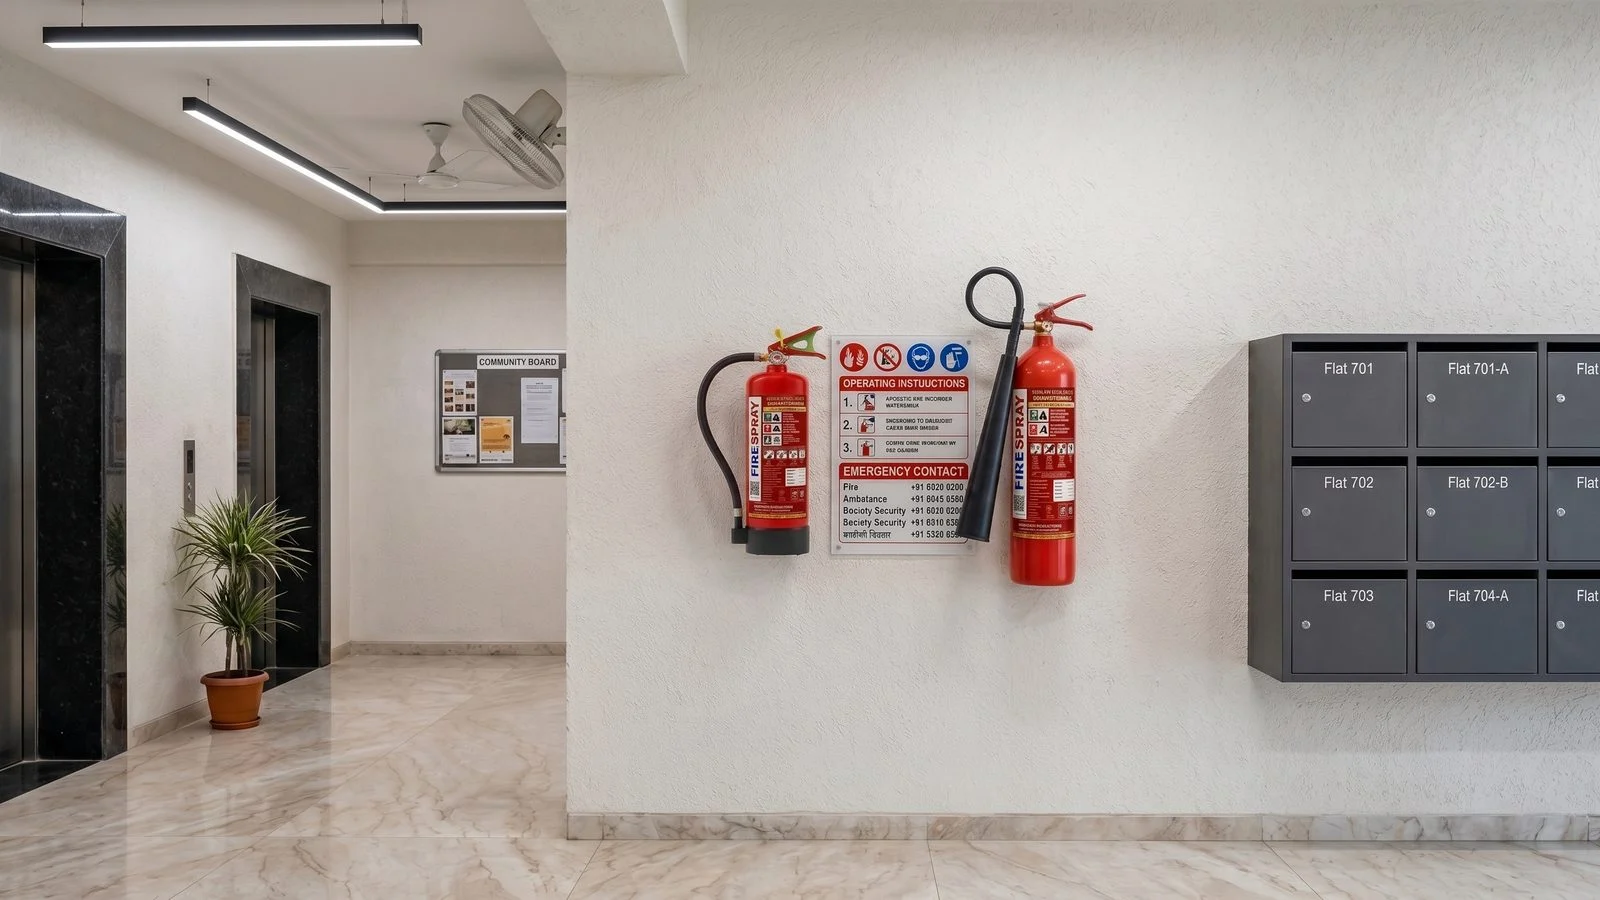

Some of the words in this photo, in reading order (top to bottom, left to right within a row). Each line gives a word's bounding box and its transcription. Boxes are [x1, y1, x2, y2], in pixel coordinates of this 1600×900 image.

[479, 358, 526, 366] COMMUNITY
[528, 358, 557, 366] BOARD
[1324, 362, 1348, 375] Flat
[1351, 362, 1374, 375] 701
[1448, 362, 1471, 375] Flat
[1474, 362, 1509, 375] 701-A
[1577, 362, 1599, 375] Flat
[843, 379, 896, 388] OPERATING
[898, 379, 965, 388] INSTUUCTIONS
[843, 398, 853, 407] 1.
[843, 420, 853, 430] 2.
[843, 443, 853, 453] 3.
[843, 466, 911, 477] EMERGENCY
[913, 466, 965, 477] CONTACT
[911, 483, 924, 491] +91
[926, 483, 944, 491] 6020
[1324, 476, 1348, 489] Flat
[1351, 476, 1374, 489] 702
[1448, 476, 1471, 489] Flat
[1474, 476, 1509, 489] 702-B
[1577, 476, 1599, 489] Flat
[911, 495, 924, 503] +91
[874, 507, 907, 516] Security
[911, 507, 924, 515] +91
[874, 519, 907, 528] Security
[911, 519, 924, 527] +91
[911, 531, 924, 539] +91
[946, 531, 962, 539] 65
[1324, 590, 1348, 603] Flat
[1351, 590, 1374, 603] 703
[1448, 590, 1471, 603] Flat
[1474, 590, 1509, 603] 704-A
[1577, 590, 1599, 603] Flat
